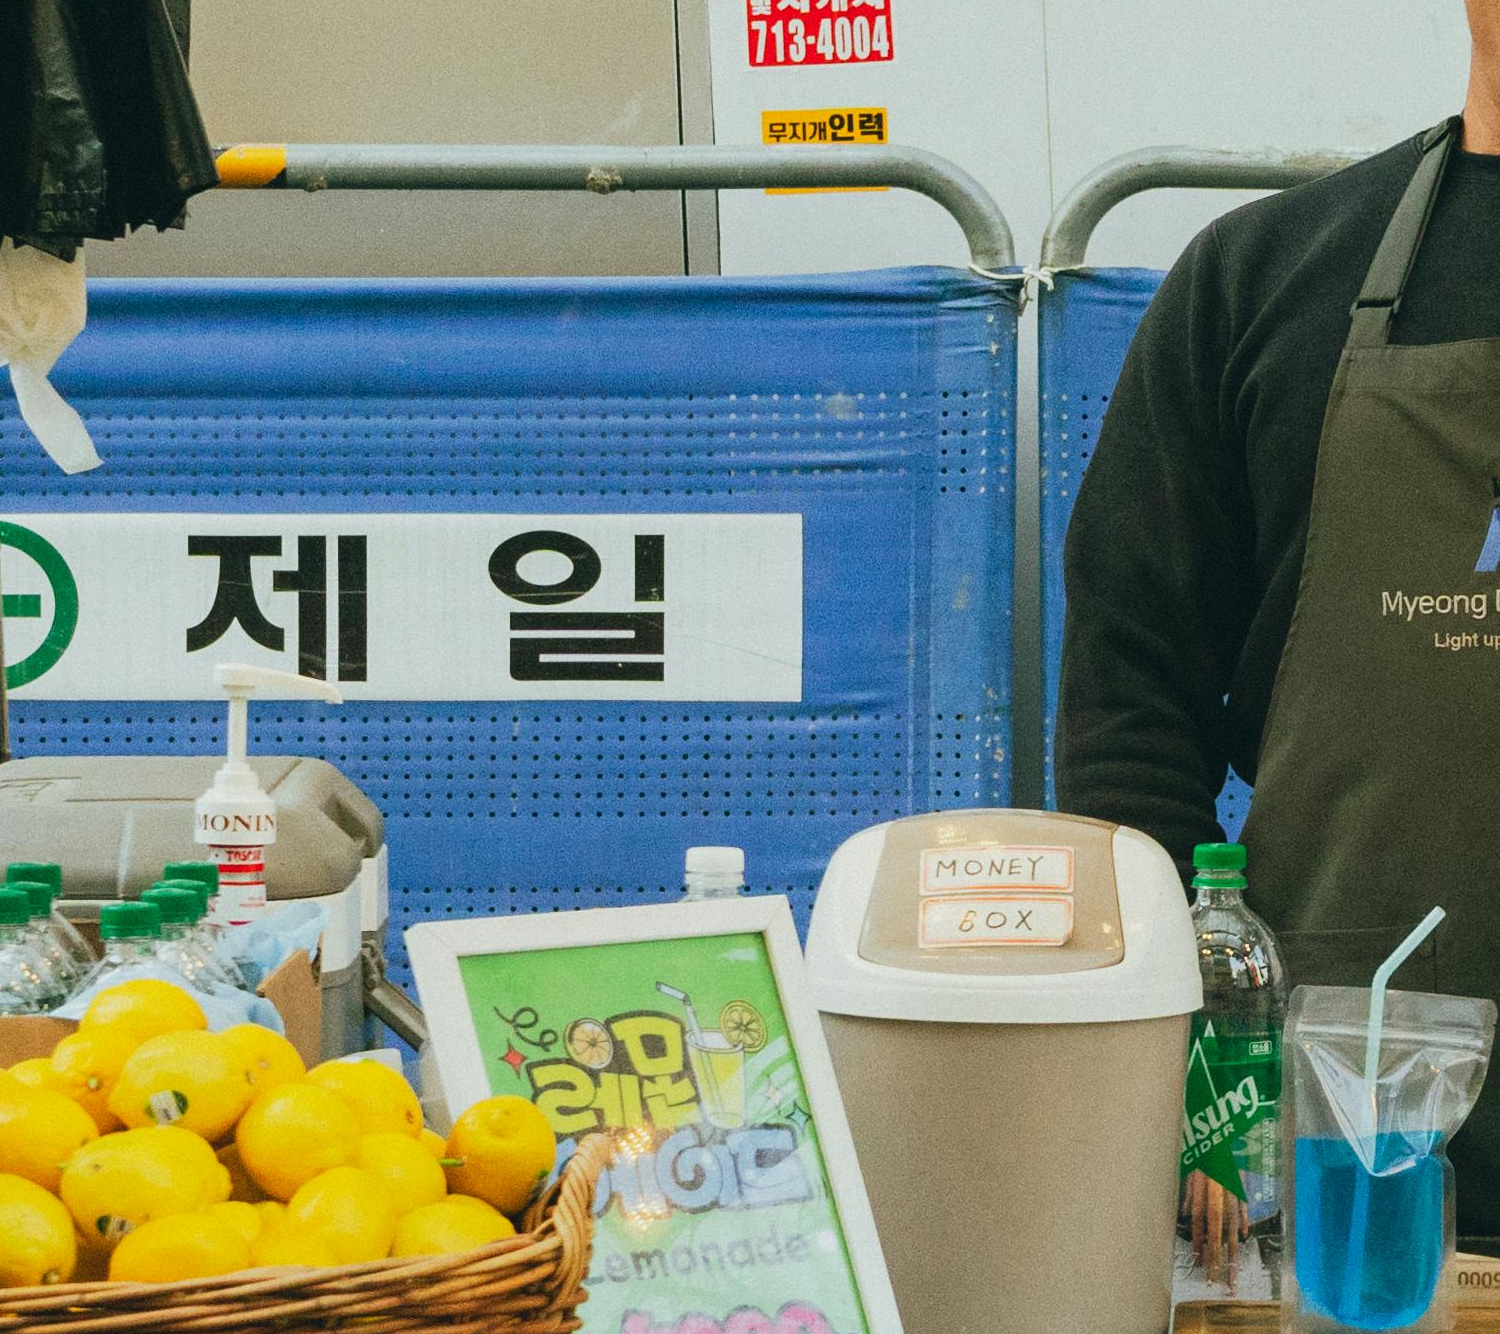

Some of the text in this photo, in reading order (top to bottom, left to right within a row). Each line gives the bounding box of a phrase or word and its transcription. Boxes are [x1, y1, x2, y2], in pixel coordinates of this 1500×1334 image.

[751, 16, 890, 63] 713-4004
[1381, 590, 1488, 622] Myeong
[1434, 632, 1480, 650] Light
[935, 855, 1045, 881] MONEY
[958, 909, 1033, 932] BOX
[529, 1010, 701, 1134] 레몬
[1182, 1075, 1259, 1151] lsung
[1183, 1122, 1235, 1165] CIDER
